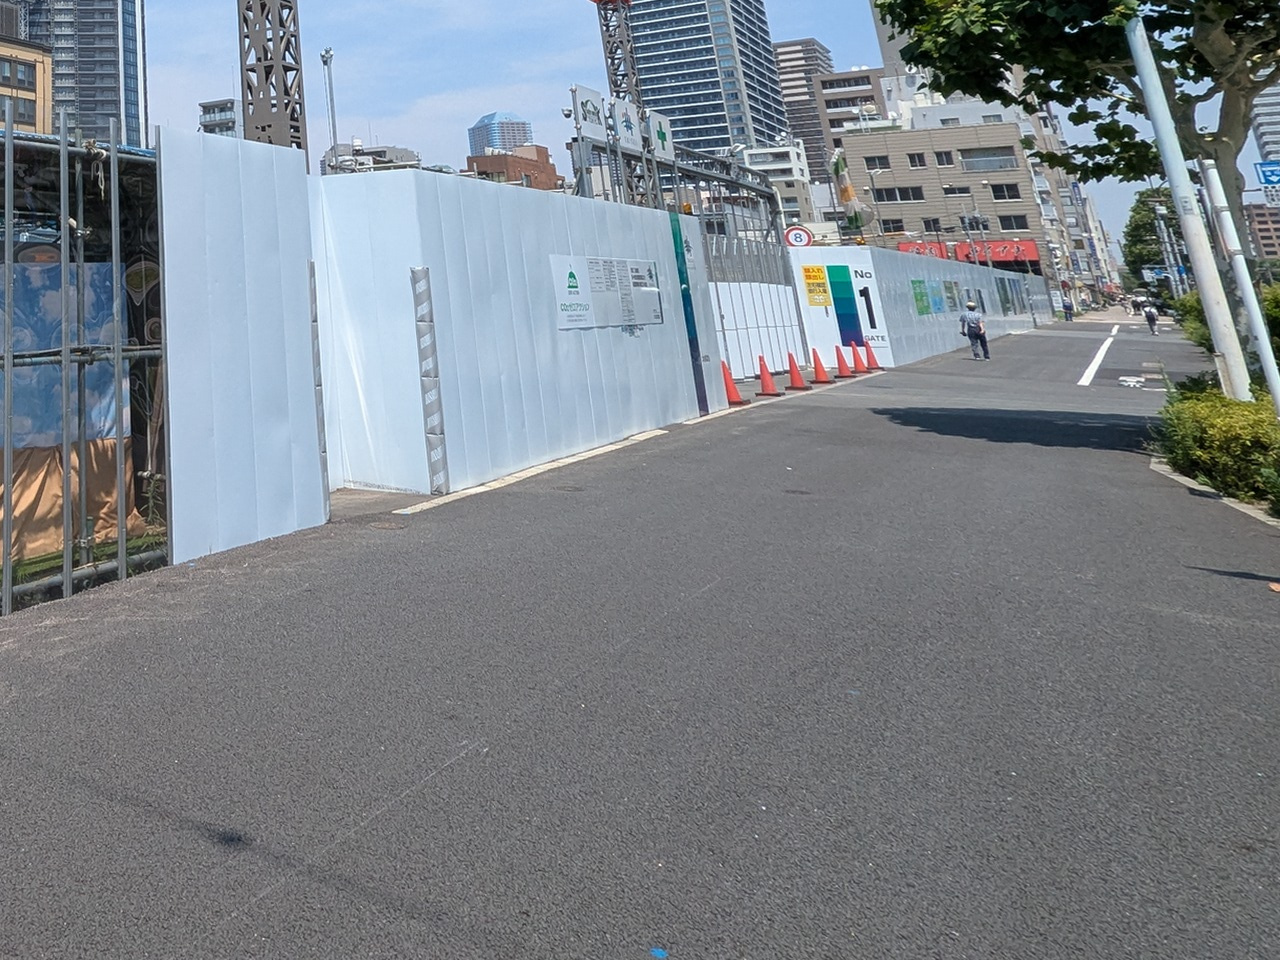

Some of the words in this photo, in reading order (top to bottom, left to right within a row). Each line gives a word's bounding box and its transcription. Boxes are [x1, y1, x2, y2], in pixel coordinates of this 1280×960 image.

[793, 232, 803, 243] 8
[854, 270, 872, 279] No
[858, 286, 877, 330] 1
[864, 335, 886, 343] GATE
